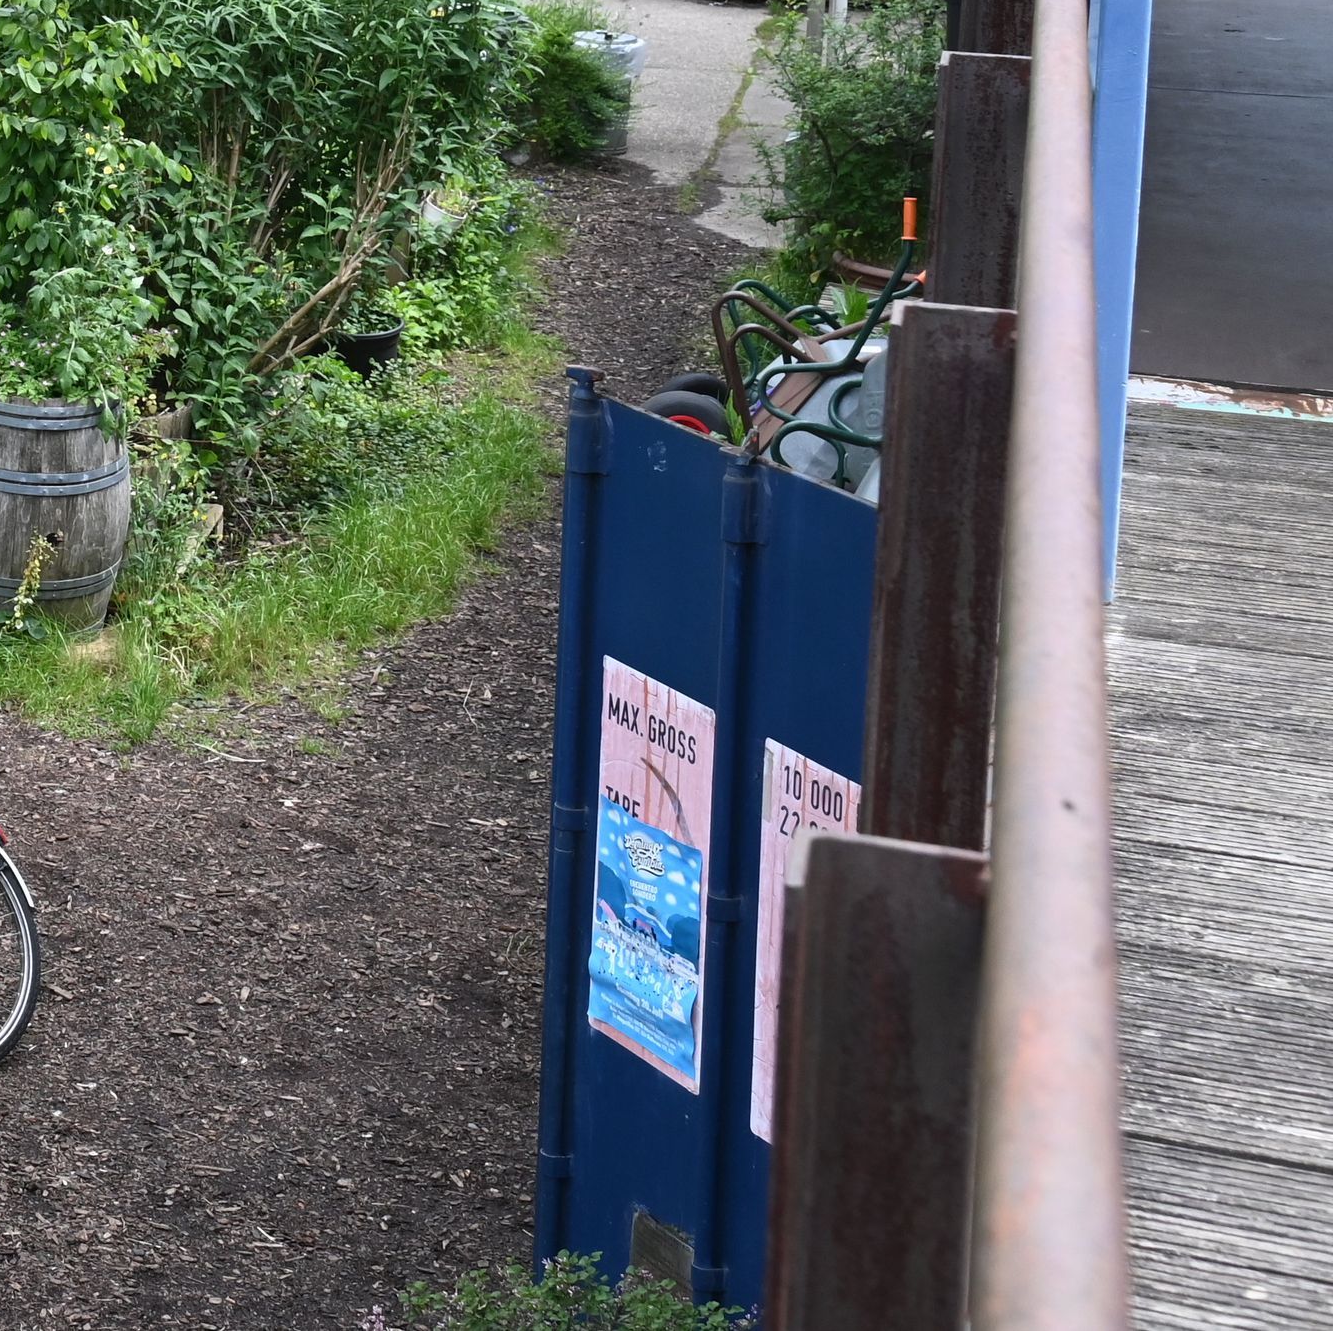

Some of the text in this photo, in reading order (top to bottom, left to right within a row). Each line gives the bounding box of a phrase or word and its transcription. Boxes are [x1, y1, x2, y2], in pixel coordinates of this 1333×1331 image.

[608, 692, 697, 765] MAX. GROSS
[784, 765, 843, 823] 10 000
